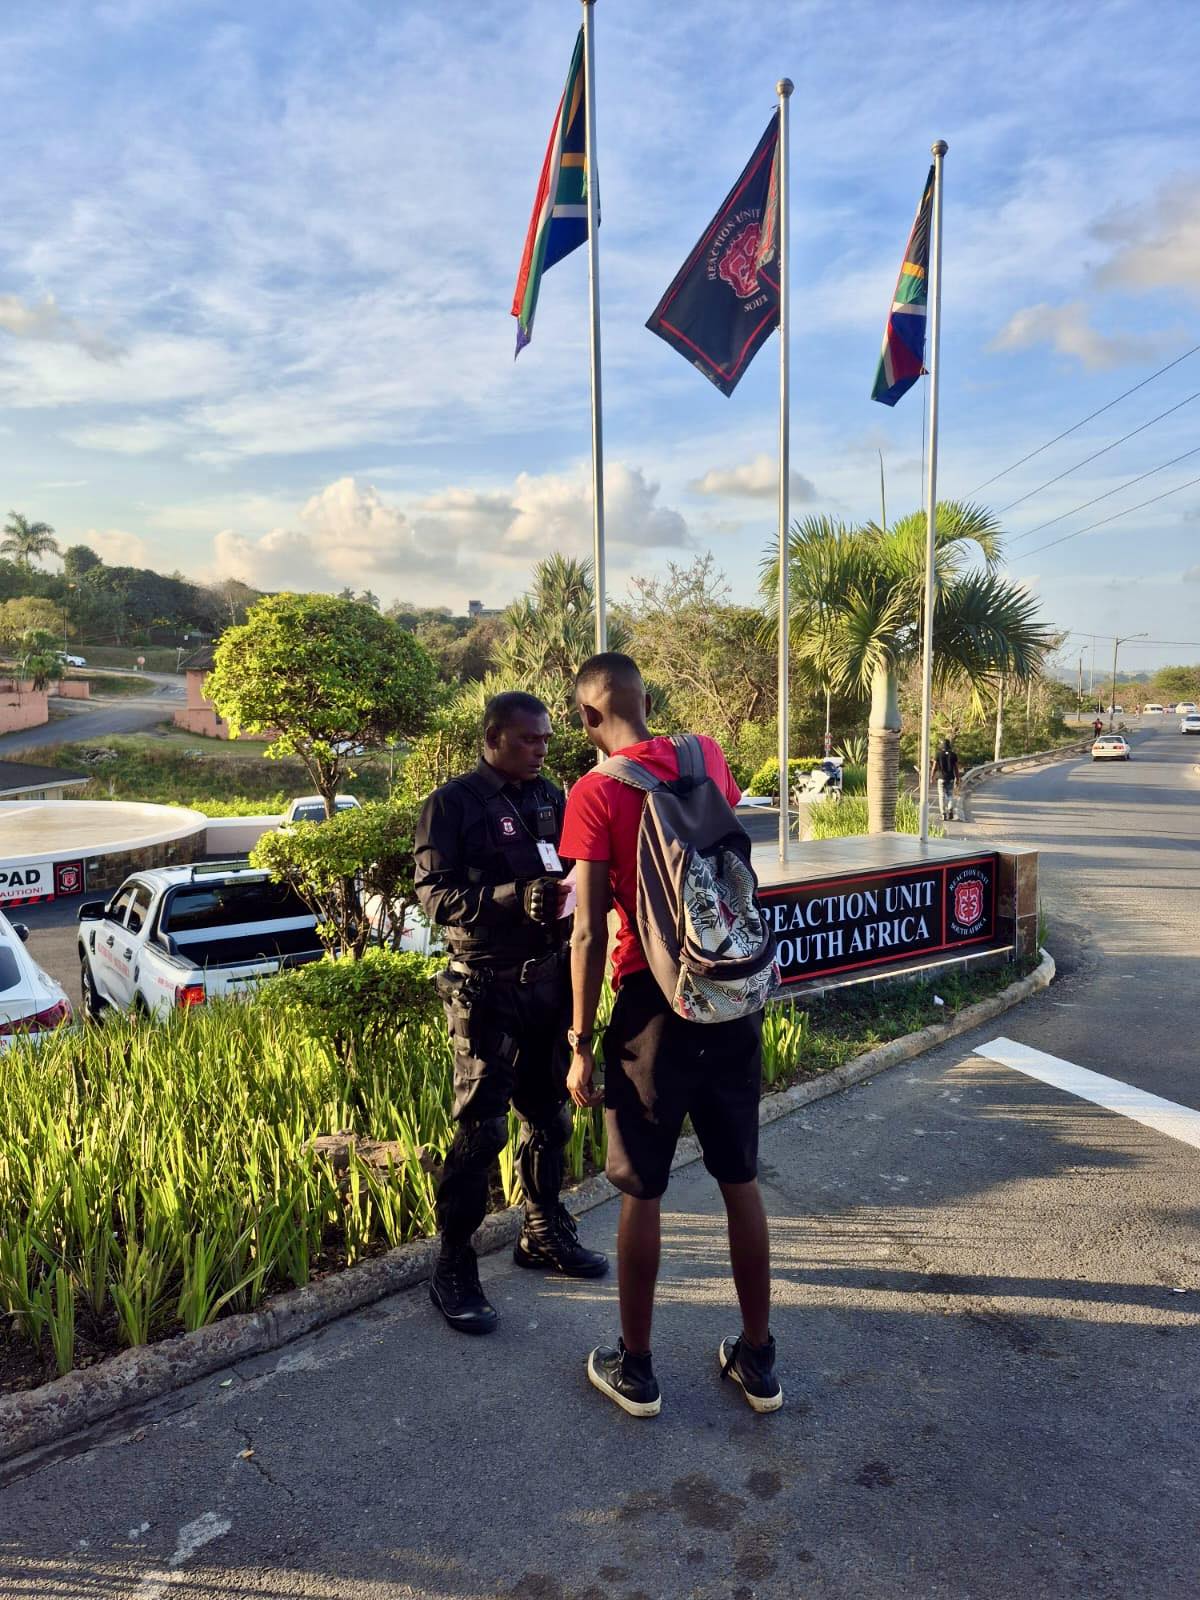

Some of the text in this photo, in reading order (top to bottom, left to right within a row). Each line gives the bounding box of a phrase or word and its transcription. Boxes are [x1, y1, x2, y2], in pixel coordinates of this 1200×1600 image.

[707, 208, 761, 281] REACTION UNIT
[0, 887, 43, 898] AUTION!
[949, 868, 976, 892] REACTION
[885, 880, 936, 913] UNIT
[776, 914, 930, 967] OUTH AFRICA
[950, 917, 987, 936] SOUTH AFRICA
